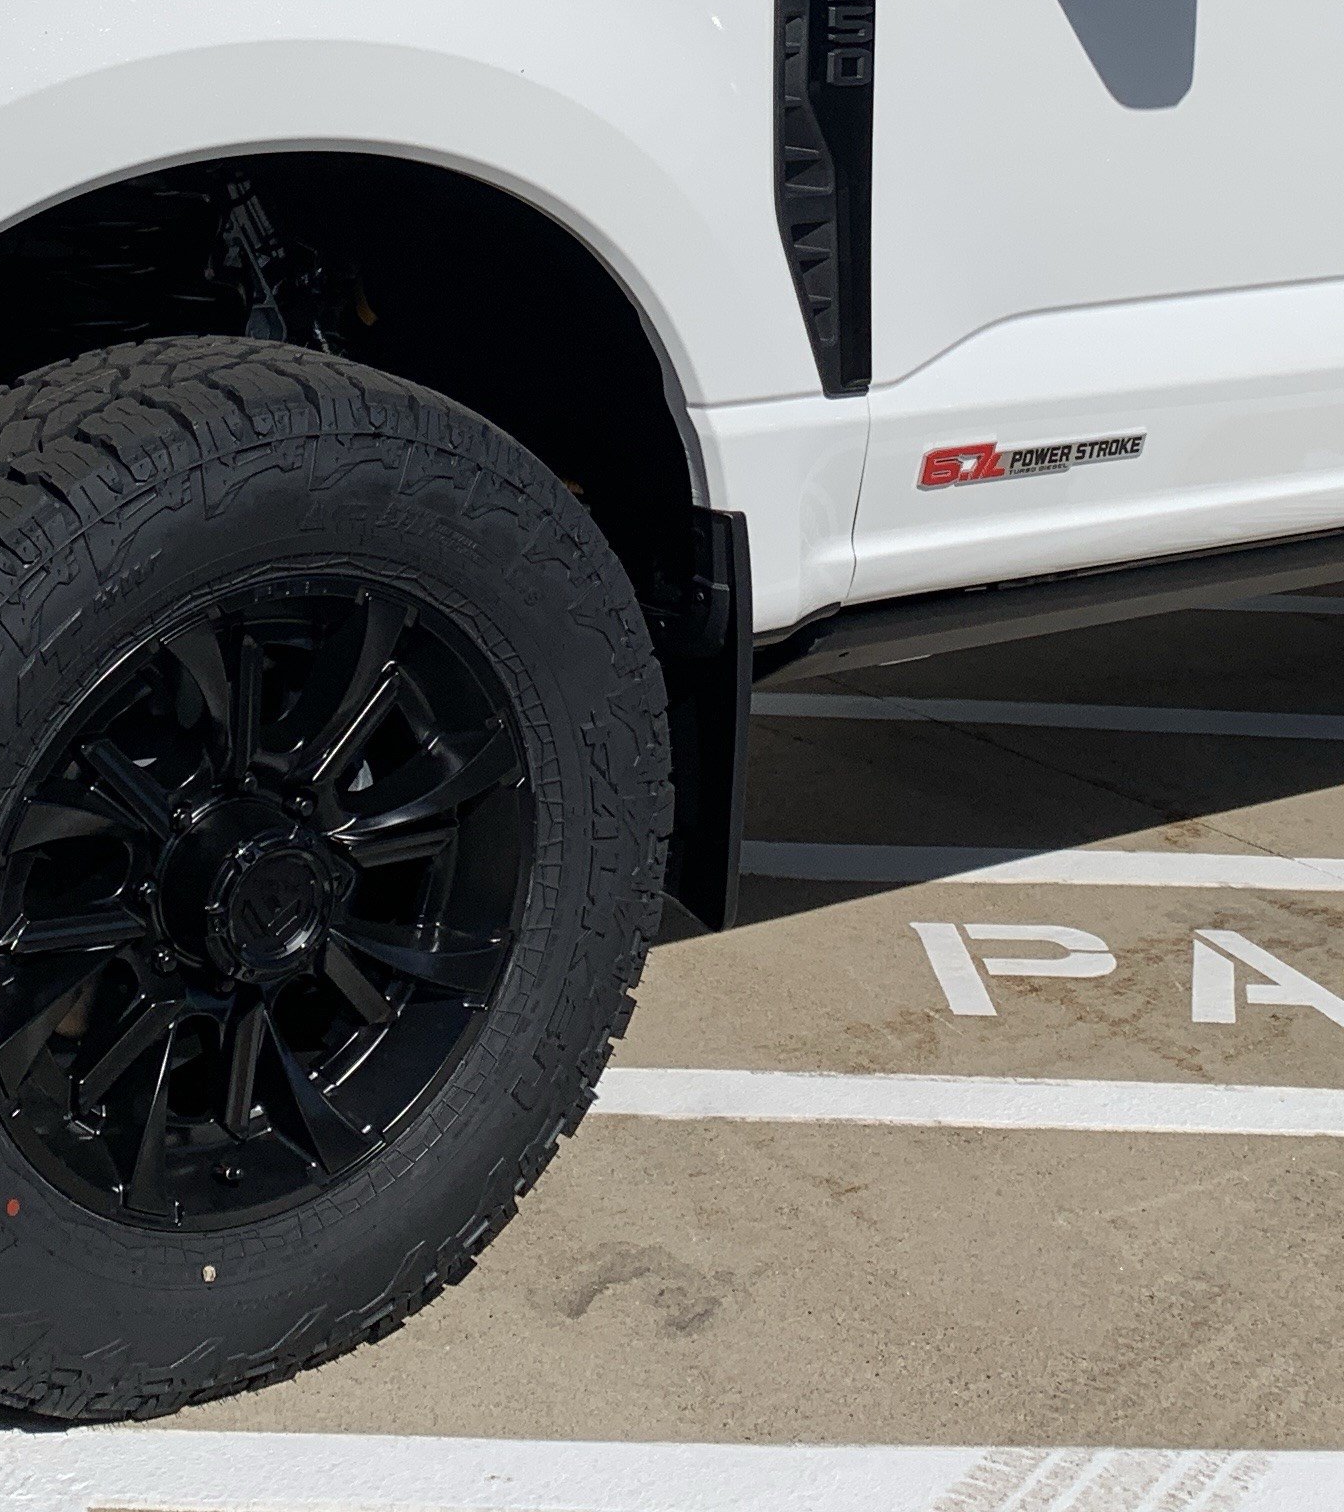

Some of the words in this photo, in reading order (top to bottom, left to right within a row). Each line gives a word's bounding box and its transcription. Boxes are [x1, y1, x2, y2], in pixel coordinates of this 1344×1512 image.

[920, 442, 1005, 486] 6.7L
[1009, 444, 1073, 469] POWER
[1074, 437, 1143, 460] STROKE
[1008, 466, 1037, 476] TURBO
[1038, 463, 1069, 473] DIESEL
